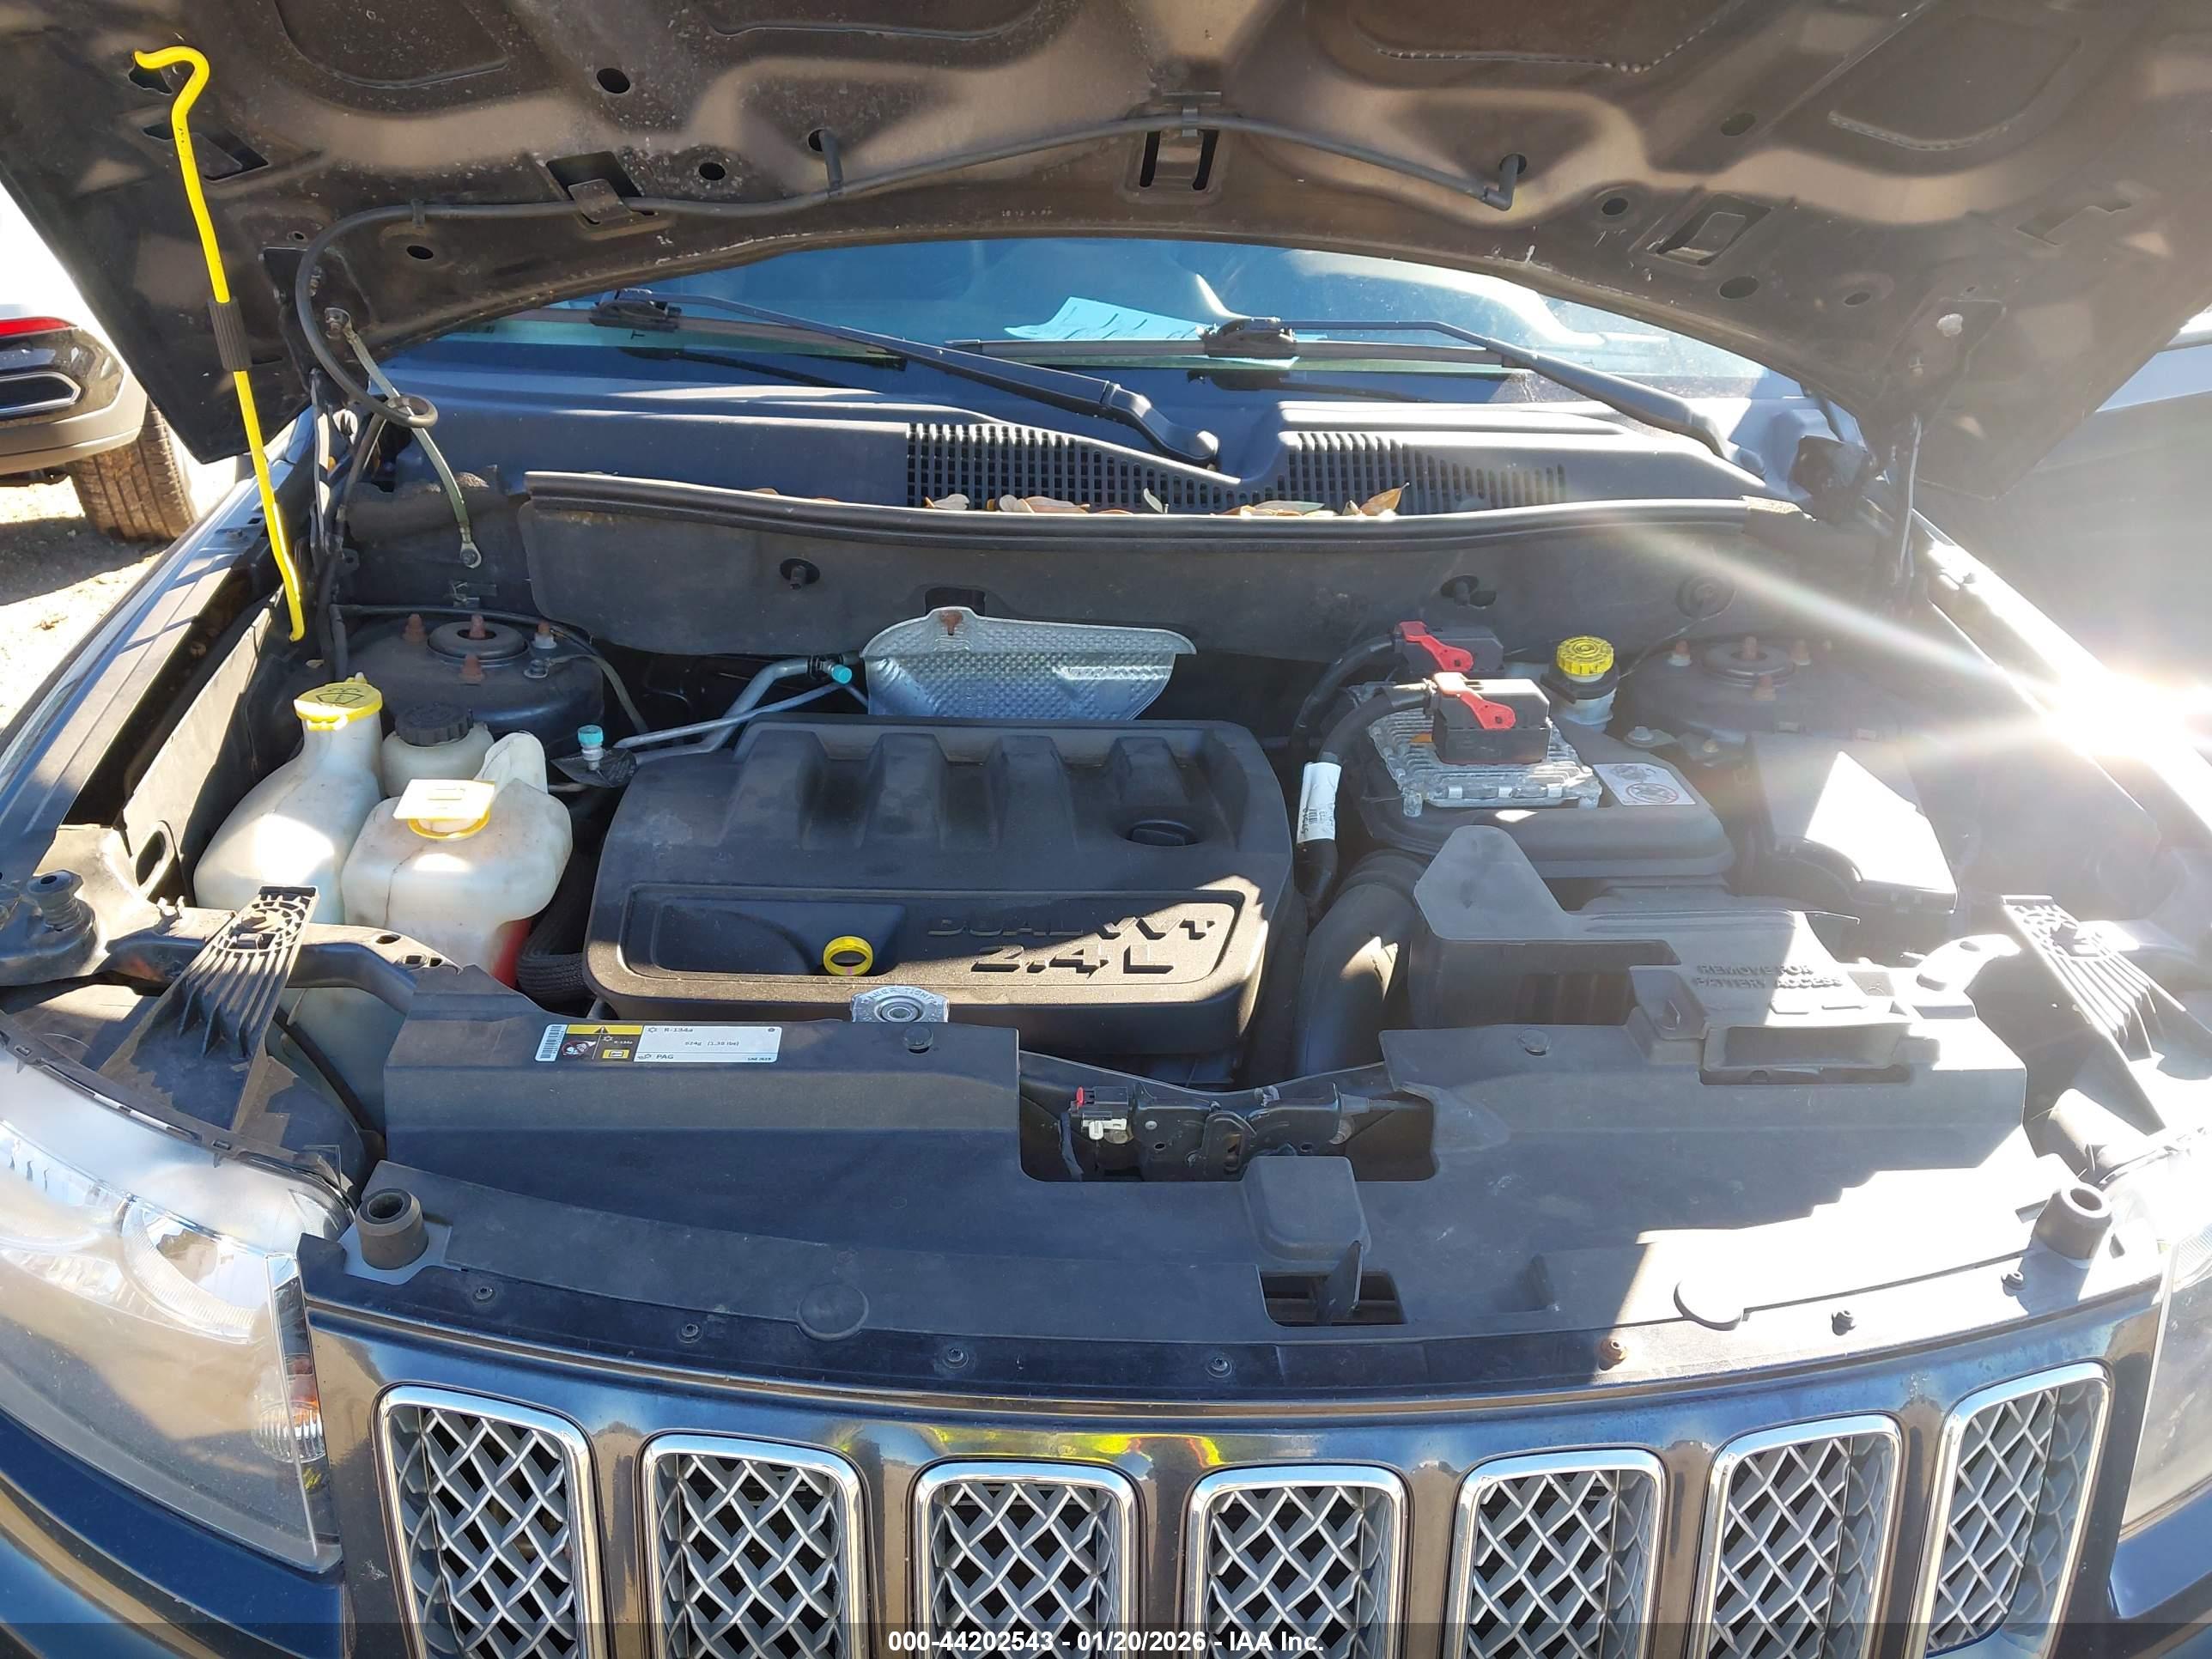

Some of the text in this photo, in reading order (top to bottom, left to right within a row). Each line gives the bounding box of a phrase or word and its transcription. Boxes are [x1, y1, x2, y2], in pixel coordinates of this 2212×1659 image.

[1097, 915, 1216, 940] VVT
[970, 944, 1175, 978] 2.4L
[1698, 964, 1814, 976] REMOVE FOR
[1692, 977, 1767, 988] BATTERY
